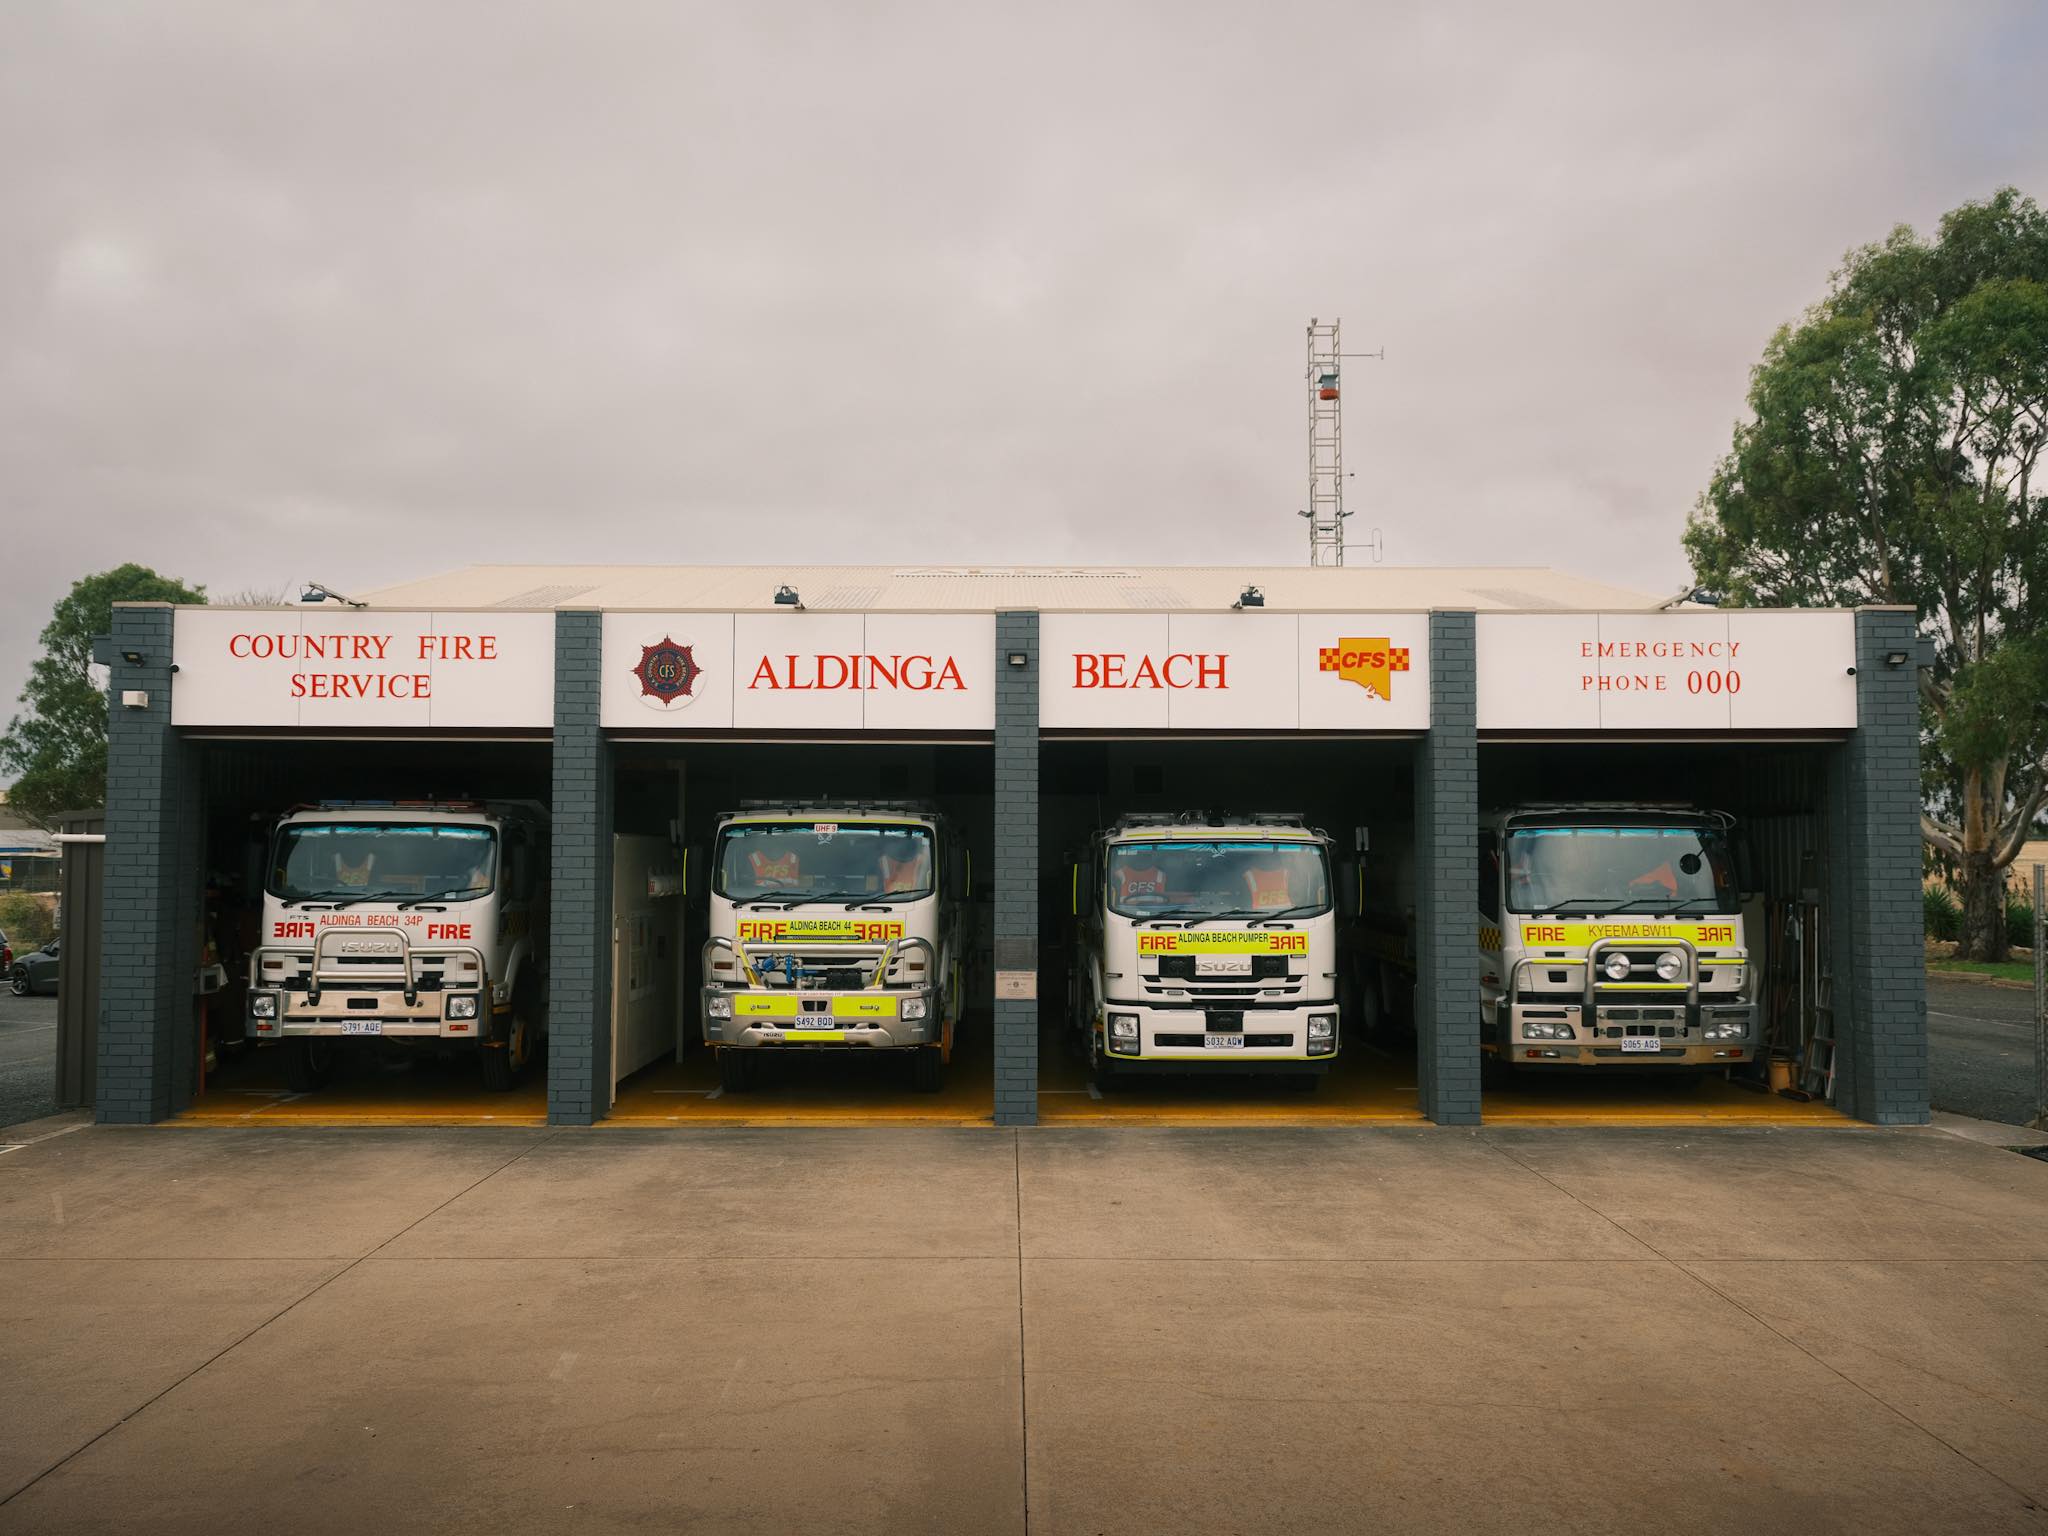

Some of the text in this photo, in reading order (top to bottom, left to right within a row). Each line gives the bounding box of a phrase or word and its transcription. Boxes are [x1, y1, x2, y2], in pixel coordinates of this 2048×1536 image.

[229, 634, 499, 660] COUNTRY FIRE
[1581, 641, 1742, 658] EMERGENCY
[1341, 651, 1386, 669] CFS
[659, 664, 675, 678] CFS
[747, 655, 968, 690] ALDINGA
[1072, 653, 1230, 689] BEACH
[290, 673, 432, 699] SERVICE
[1582, 670, 1742, 694] PHONE 000
[1127, 880, 1156, 893] CFS
[320, 914, 423, 926] ALDINGA BEACH 34P
[789, 920, 852, 931] ALDINGA BEACH 44
[427, 923, 472, 940] FIRE
[740, 922, 787, 939] FIRE
[1526, 927, 1566, 941] FIRE
[1588, 925, 1672, 937] KYEEMA BW11
[1140, 936, 1177, 950] FIRE
[1178, 933, 1269, 943] ALDINGA BEACH PUMPER
[341, 942, 399, 953] ISUZU
[1195, 962, 1252, 972] ISUZU
[796, 1017, 815, 1026] S492
